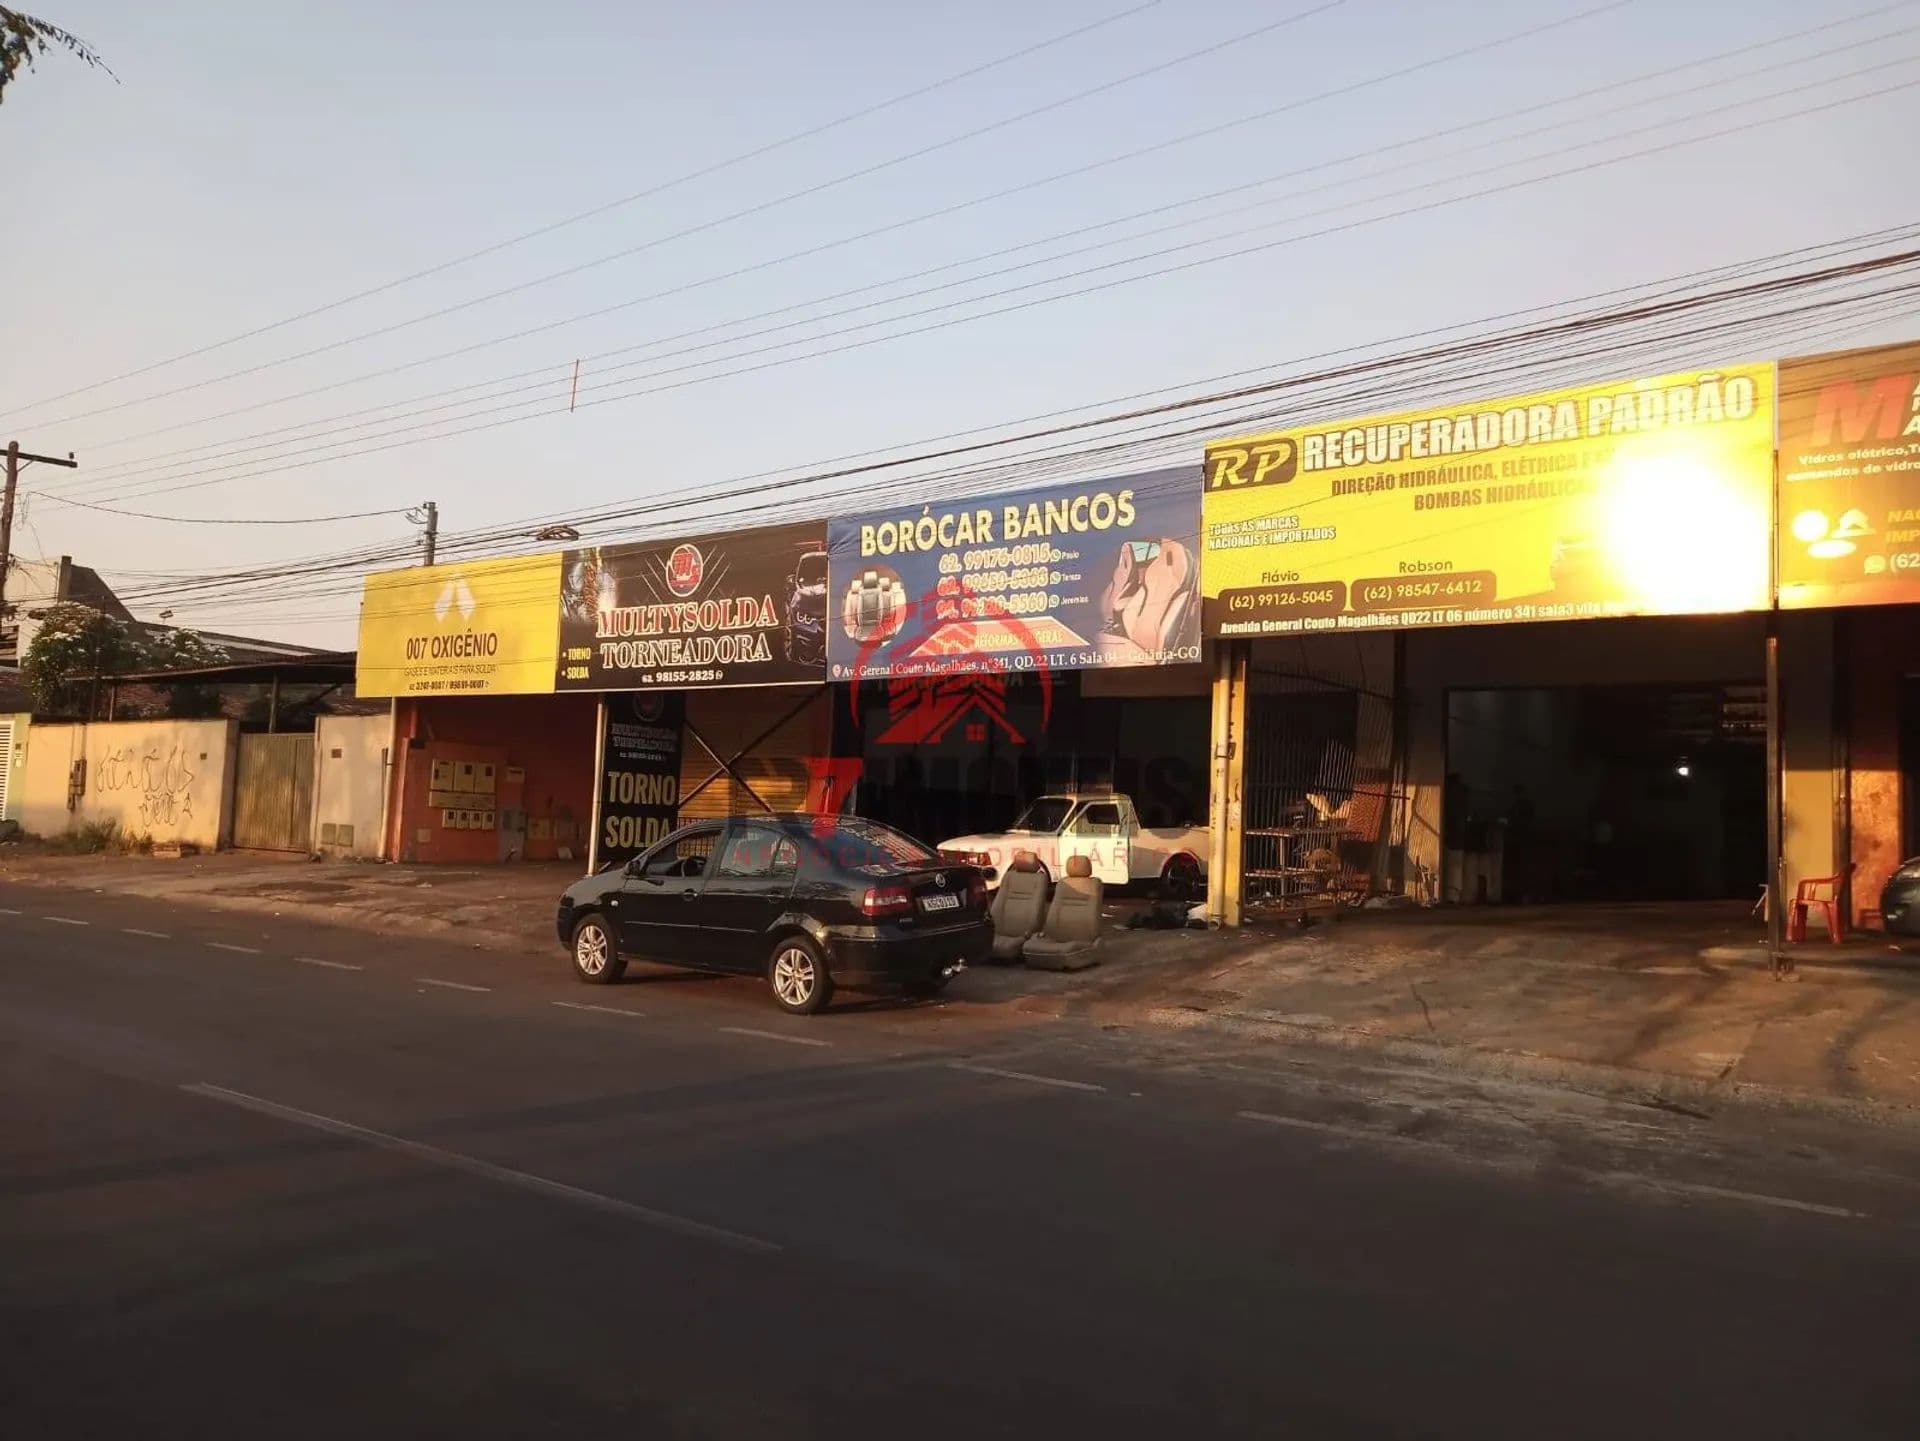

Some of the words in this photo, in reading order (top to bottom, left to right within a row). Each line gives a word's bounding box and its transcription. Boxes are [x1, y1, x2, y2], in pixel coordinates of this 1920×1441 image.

[1302, 400, 1580, 472] RECUPERADORA
[1586, 372, 1757, 437] PADRÃO
[1208, 442, 1293, 488] RP
[1331, 473, 1396, 496] DIREÇÃO
[1399, 463, 1498, 489] HIDRÁULICA,
[1501, 455, 1580, 478] ELÉTRICA
[1862, 464, 1882, 475] de
[1413, 487, 1483, 511] BOMBAS
[860, 505, 994, 557] BORÓCAR
[1003, 490, 1136, 541] BANCOS
[1209, 521, 1240, 536] TODAS
[1241, 520, 1255, 533] AS
[1256, 516, 1299, 531] MARCAS
[1209, 534, 1260, 550] NACIONAIS
[1261, 533, 1269, 545] E
[1269, 527, 1336, 544] IMPORTADOS
[1261, 570, 1300, 584] Flávio
[1399, 560, 1453, 574] Robson
[1229, 593, 1255, 611] (62)
[1257, 589, 1334, 608] 99126-5045
[1363, 585, 1393, 603] (62)
[1396, 579, 1482, 597] 98547-6412
[596, 594, 779, 638] MULTYSOLDA
[1220, 621, 1261, 634] Avenida
[1262, 618, 1302, 633] General
[1303, 617, 1336, 630] Couto
[1337, 612, 1399, 629] Magalhães
[1446, 608, 1463, 622] 06
[1464, 605, 1513, 622] número
[1514, 604, 1536, 618] 341
[406, 637, 428, 660] 007
[431, 627, 498, 659] OXIGÊNIO
[567, 647, 591, 661] TORNO
[600, 632, 773, 669] TORNEADORA
[1014, 653, 1049, 669] QD.22
[1070, 652, 1077, 666] 6
[1079, 650, 1103, 665] Sala
[566, 666, 590, 680] SOLDA
[656, 669, 715, 682] 98155-2825
[607, 770, 676, 806] TORNO
